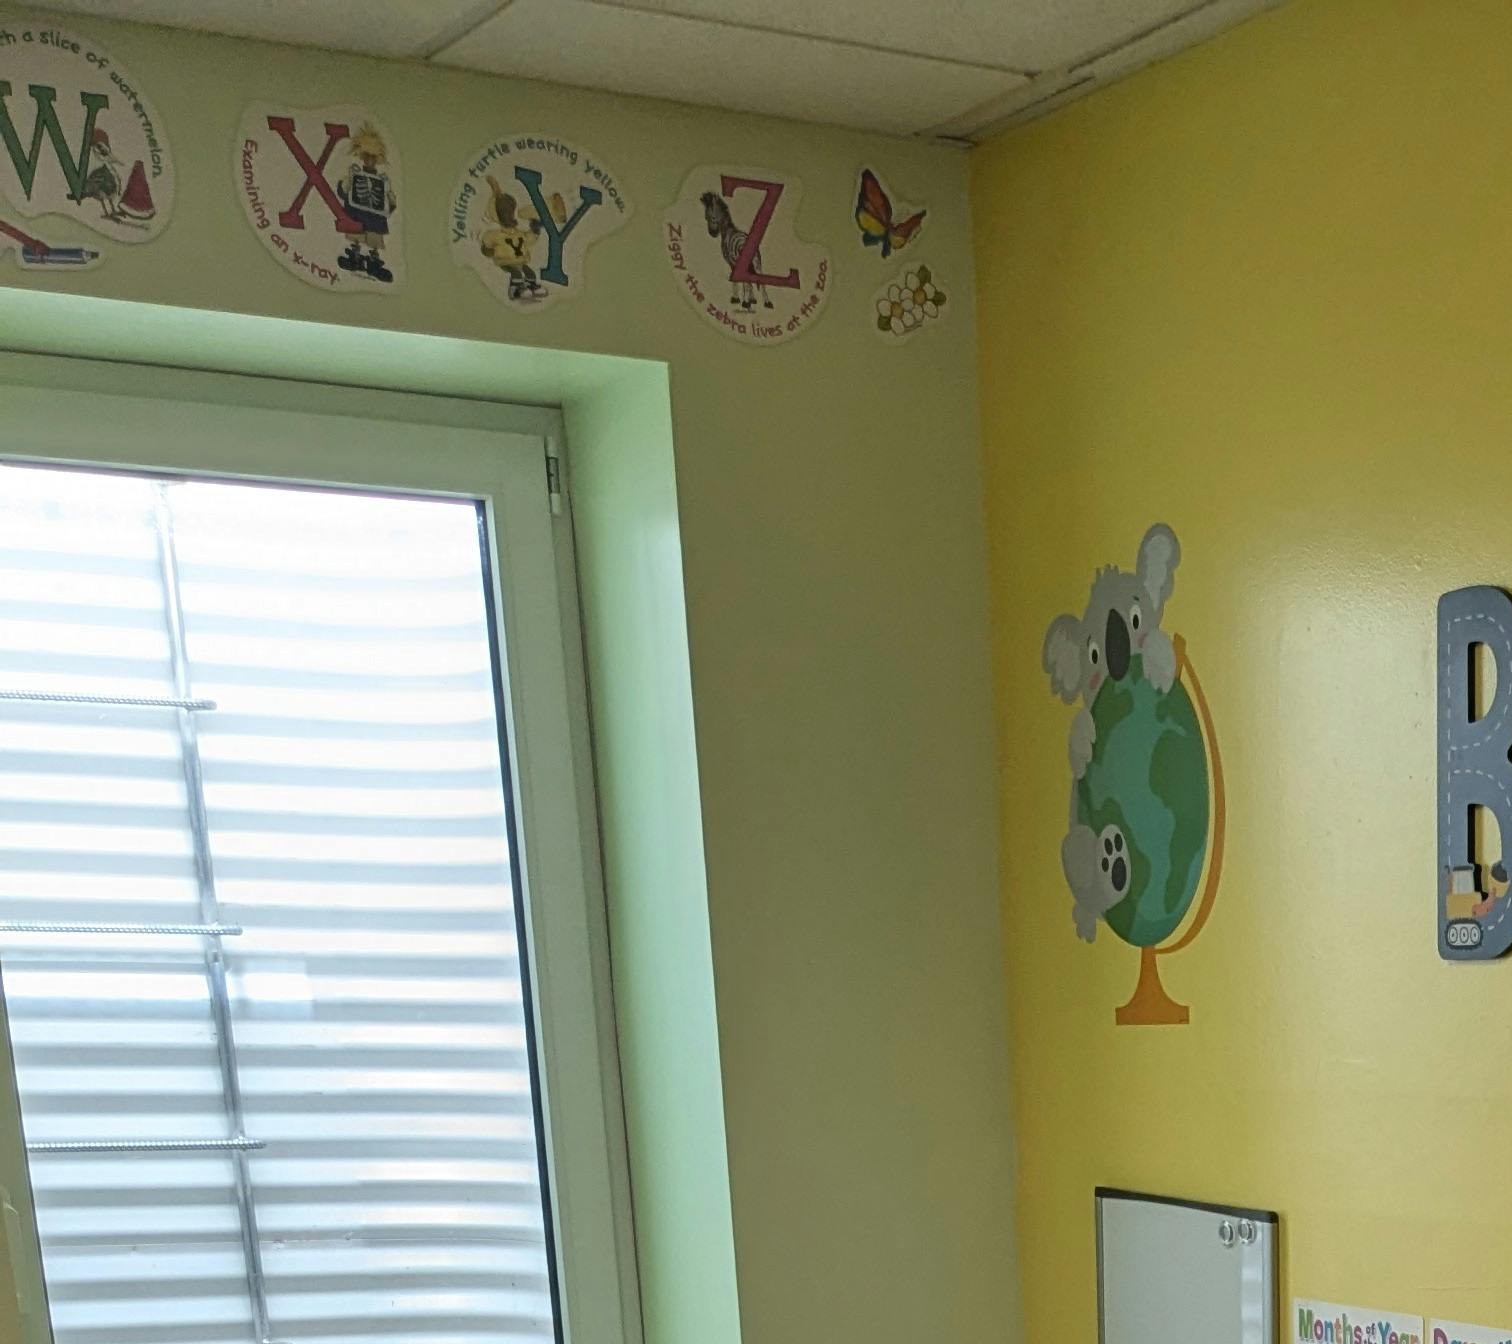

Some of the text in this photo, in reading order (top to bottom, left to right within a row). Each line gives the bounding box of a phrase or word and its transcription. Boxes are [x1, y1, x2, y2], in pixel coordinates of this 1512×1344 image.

[0, 80, 109, 206] W
[24, 30, 35, 42] a
[39, 29, 80, 55] slice
[86, 50, 108, 69] of
[110, 72, 163, 178] watermelon
[243, 138, 271, 231] Examining
[271, 232, 290, 253] an
[267, 115, 365, 234] X
[452, 182, 476, 243] Yelling
[468, 143, 511, 179] turtle
[515, 138, 578, 166] wearing
[514, 165, 603, 287] Y
[720, 174, 801, 290] Z
[666, 222, 687, 272] Ziggy
[705, 303, 748, 337] zebra
[750, 320, 784, 338] lives
[1365, 1322, 1377, 1337] of
